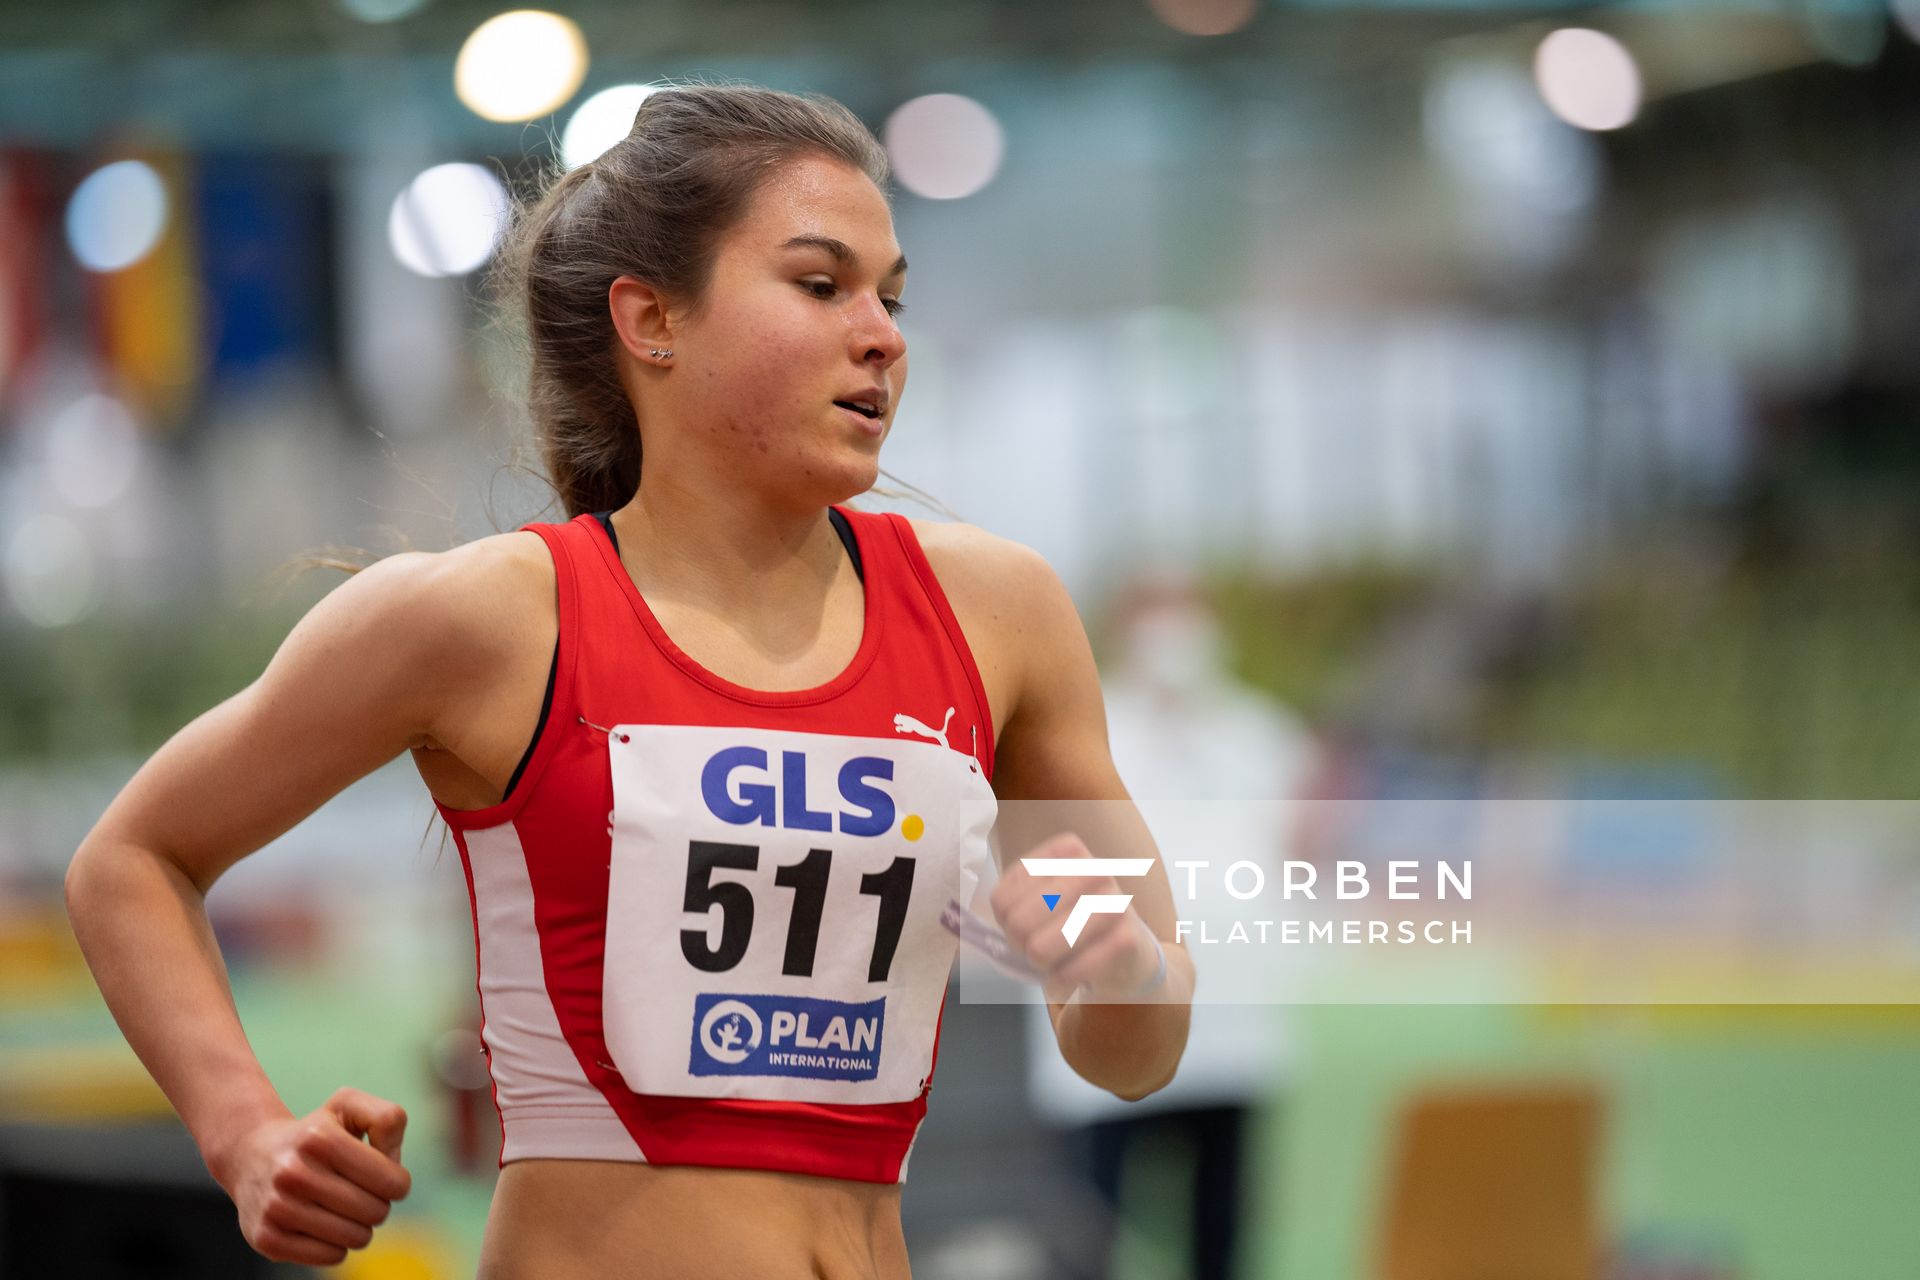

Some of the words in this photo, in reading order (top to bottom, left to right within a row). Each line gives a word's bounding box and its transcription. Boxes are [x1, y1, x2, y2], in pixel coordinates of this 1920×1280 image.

[680, 839, 917, 983] 511
[769, 1011, 878, 1051] PLAN
[768, 1052, 873, 1071] INTERNATIONAL
